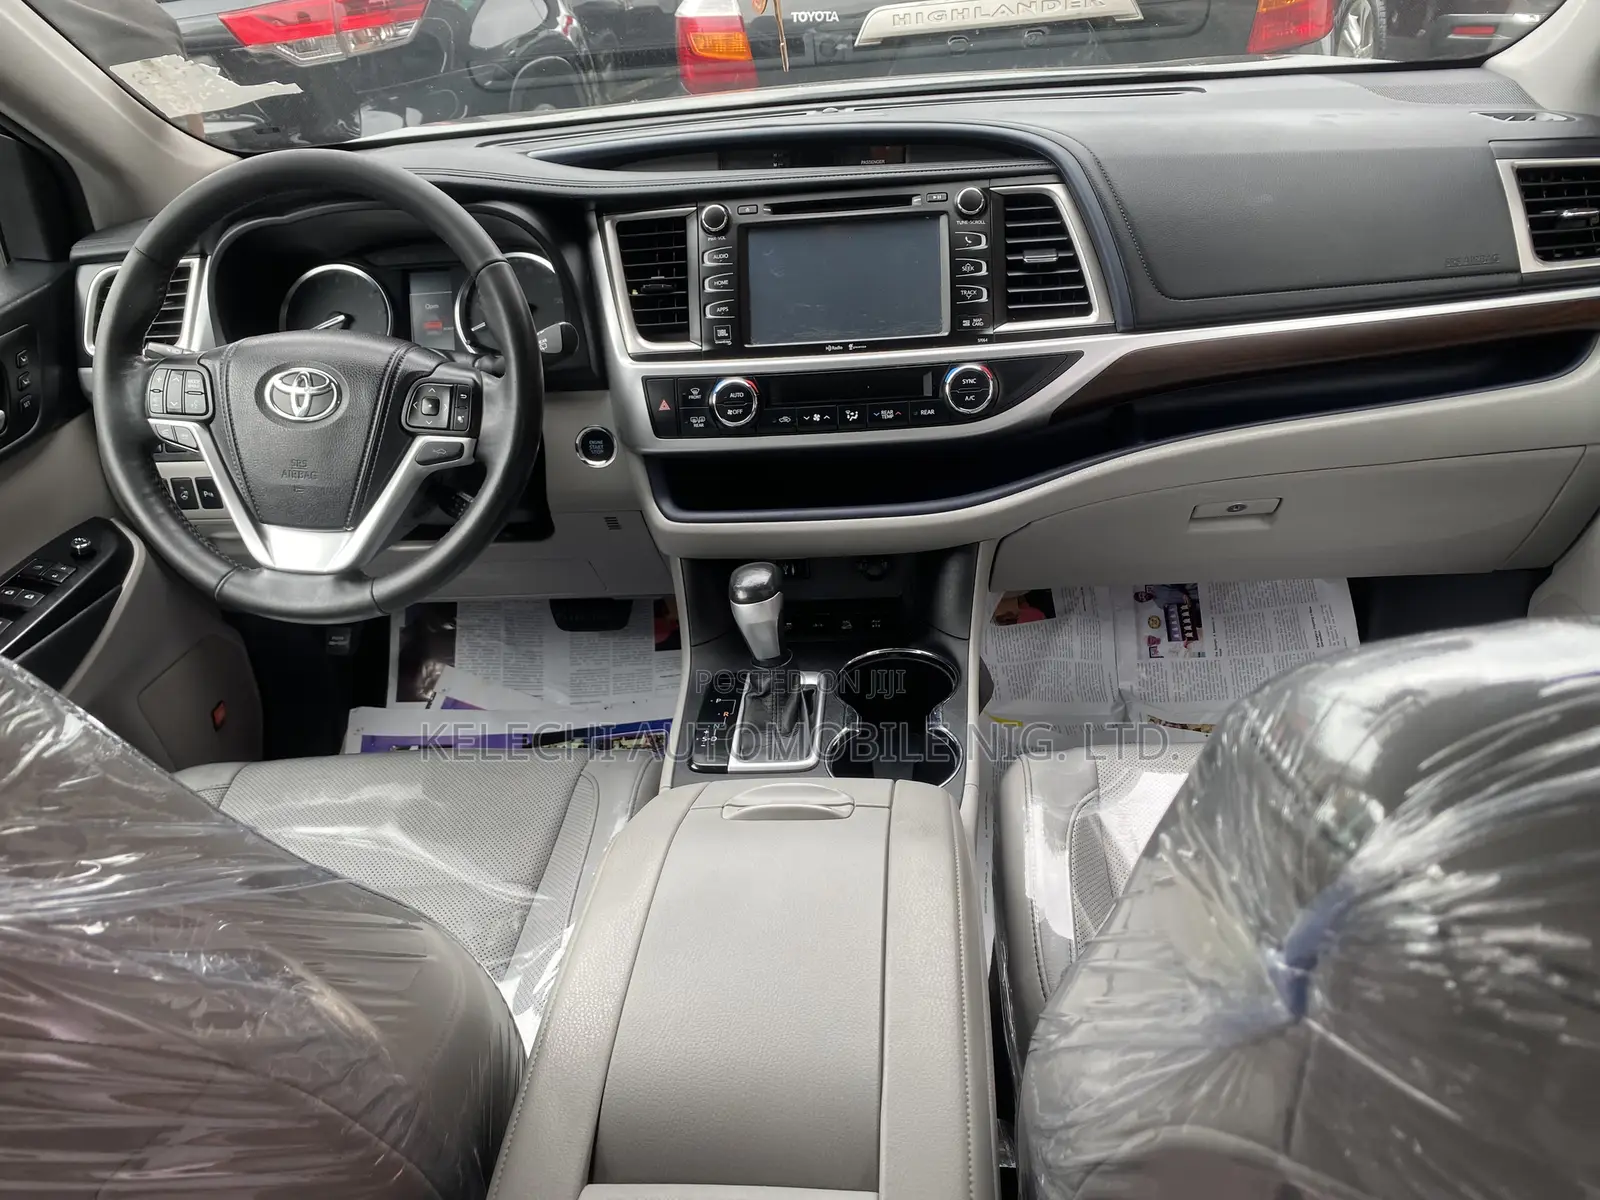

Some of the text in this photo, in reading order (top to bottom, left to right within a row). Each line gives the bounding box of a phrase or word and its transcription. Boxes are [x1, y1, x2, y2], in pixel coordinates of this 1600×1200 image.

[791, 11, 839, 22] TOYOTA
[961, 377, 977, 385] SYNC
[729, 391, 744, 399] AUTO
[964, 394, 976, 402] A/C
[920, 408, 935, 416] REAR
[280, 468, 318, 479] AIRBAG
